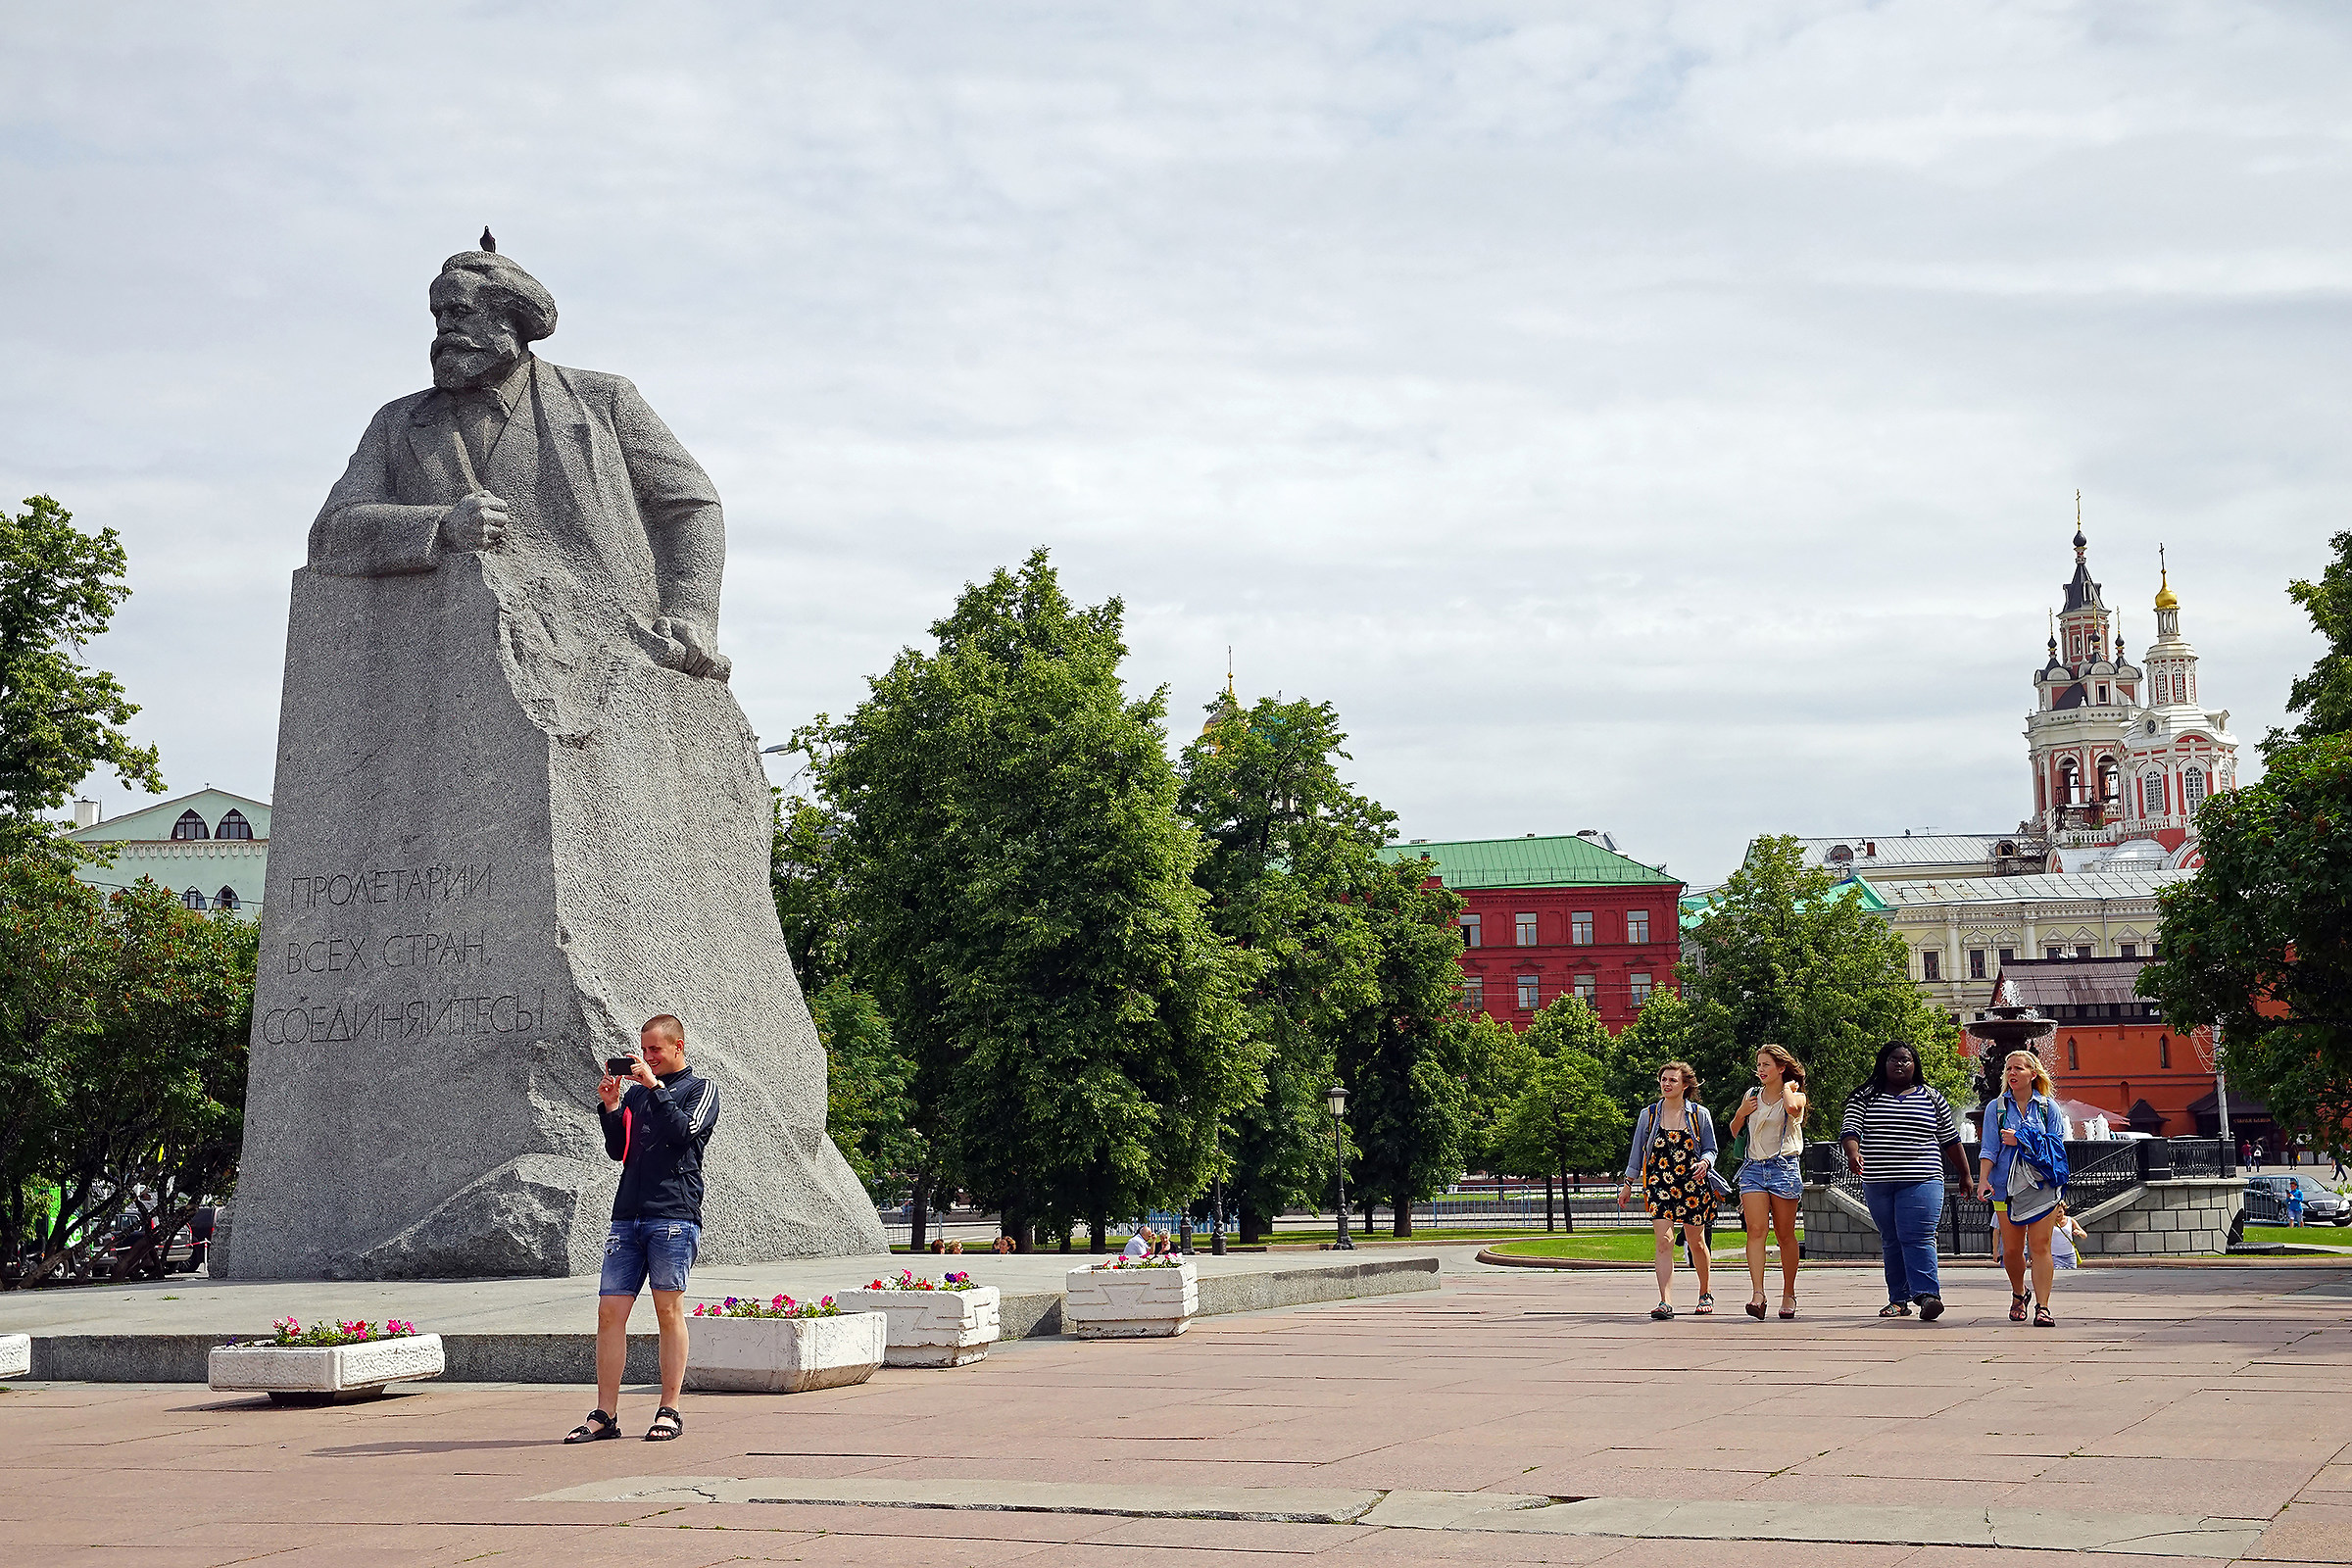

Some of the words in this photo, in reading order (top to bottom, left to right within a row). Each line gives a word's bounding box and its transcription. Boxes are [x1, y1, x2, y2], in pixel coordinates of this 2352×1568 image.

[291, 862, 492, 908] ПРОЛЕТАРИИ
[287, 937, 368, 974] ВСЕХ
[382, 930, 492, 967] СТРАН,
[263, 988, 546, 1045] СОЕДИНЯЙТЕСЬ!
